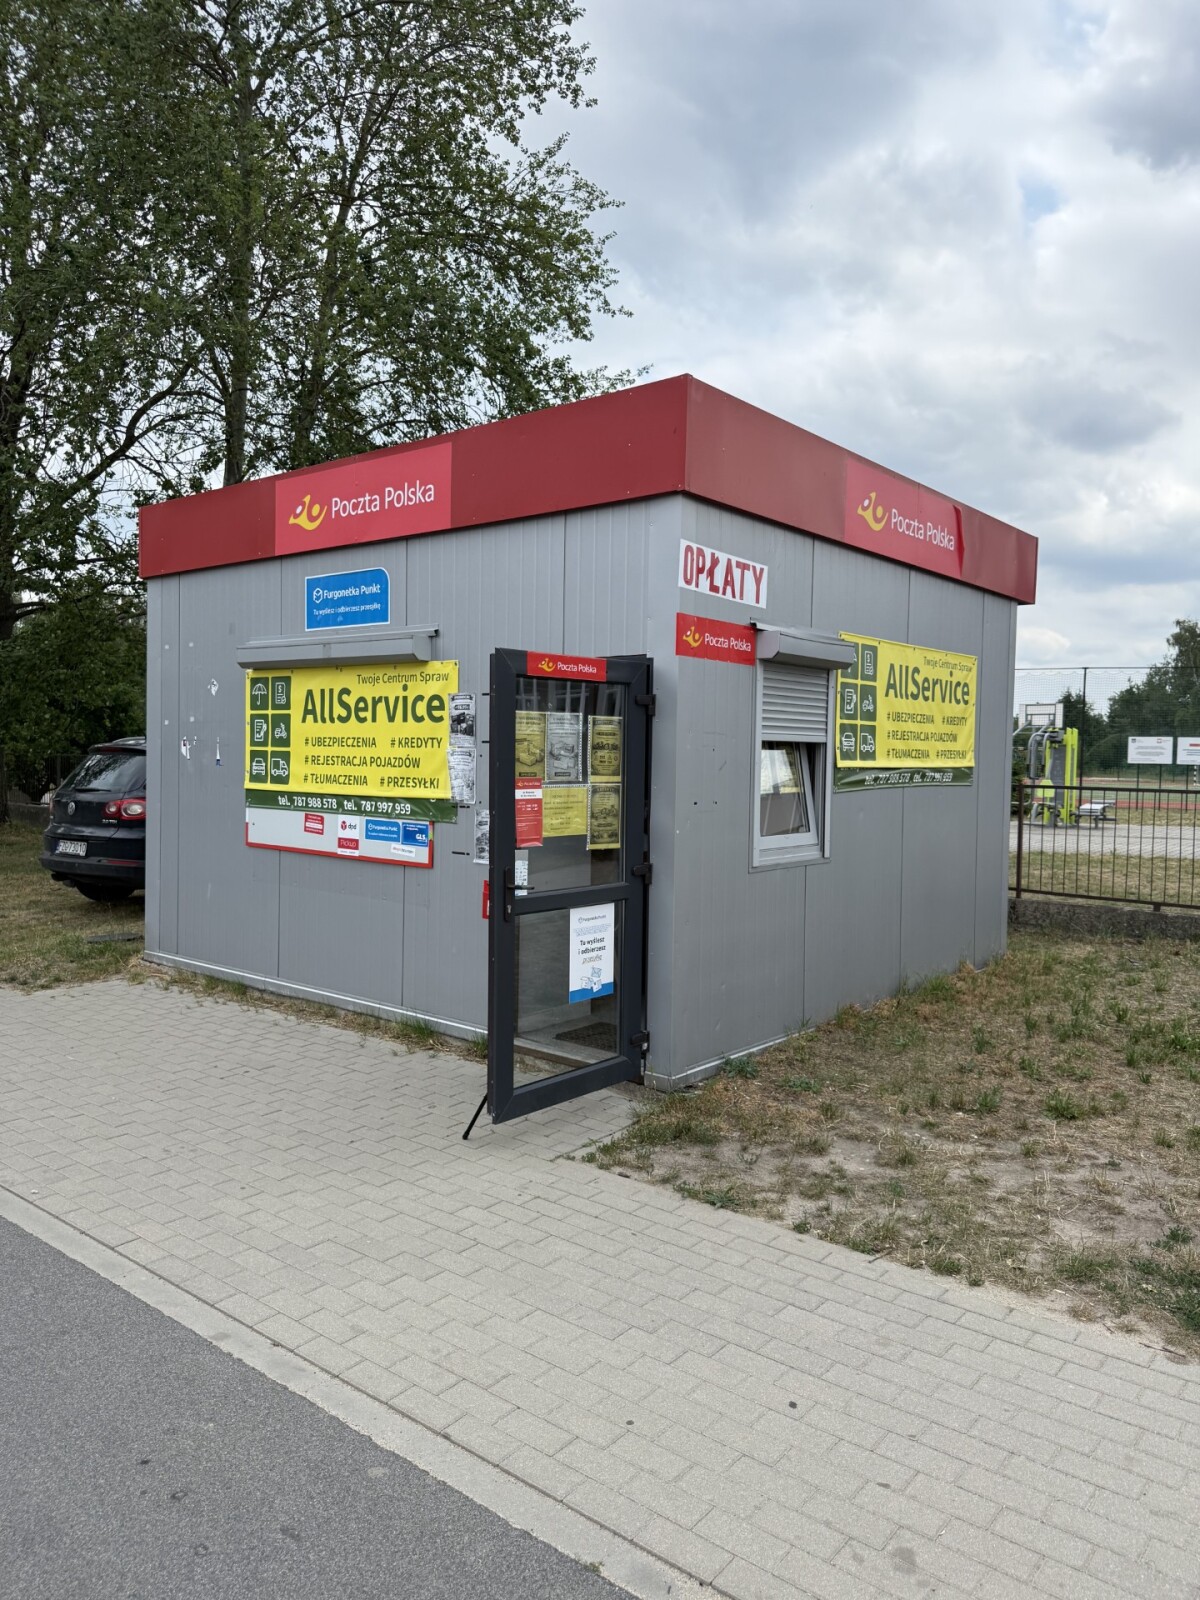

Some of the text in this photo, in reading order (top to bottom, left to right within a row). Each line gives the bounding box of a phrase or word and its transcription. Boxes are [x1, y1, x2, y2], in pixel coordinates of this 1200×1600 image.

[332, 480, 434, 519] Poczta Polska
[891, 508, 954, 550] Poczta Polska
[683, 545, 764, 604] OPŁATY
[324, 583, 380, 599] Furgonetka Punkt
[704, 634, 751, 651] Poczta Polska
[558, 662, 597, 673] Poczta Polska
[357, 671, 449, 686] Twoje Centrum Spraw
[885, 663, 969, 705] AllService
[301, 684, 445, 724] AllService
[892, 712, 934, 724] UBEZPIECZENIA
[311, 737, 377, 748] UBEZPIECZENIA
[398, 737, 442, 748] KREDYTY
[892, 730, 929, 741] REJESTRACJA
[311, 755, 368, 767] REJESTRACJA
[370, 755, 421, 768] POJAZDÓW
[310, 774, 368, 786] TŁUMACZENIA
[387, 776, 439, 789] PRZESYŁKI
[278, 796, 410, 814] tel. 787 988 578 tel. 787 997 959
